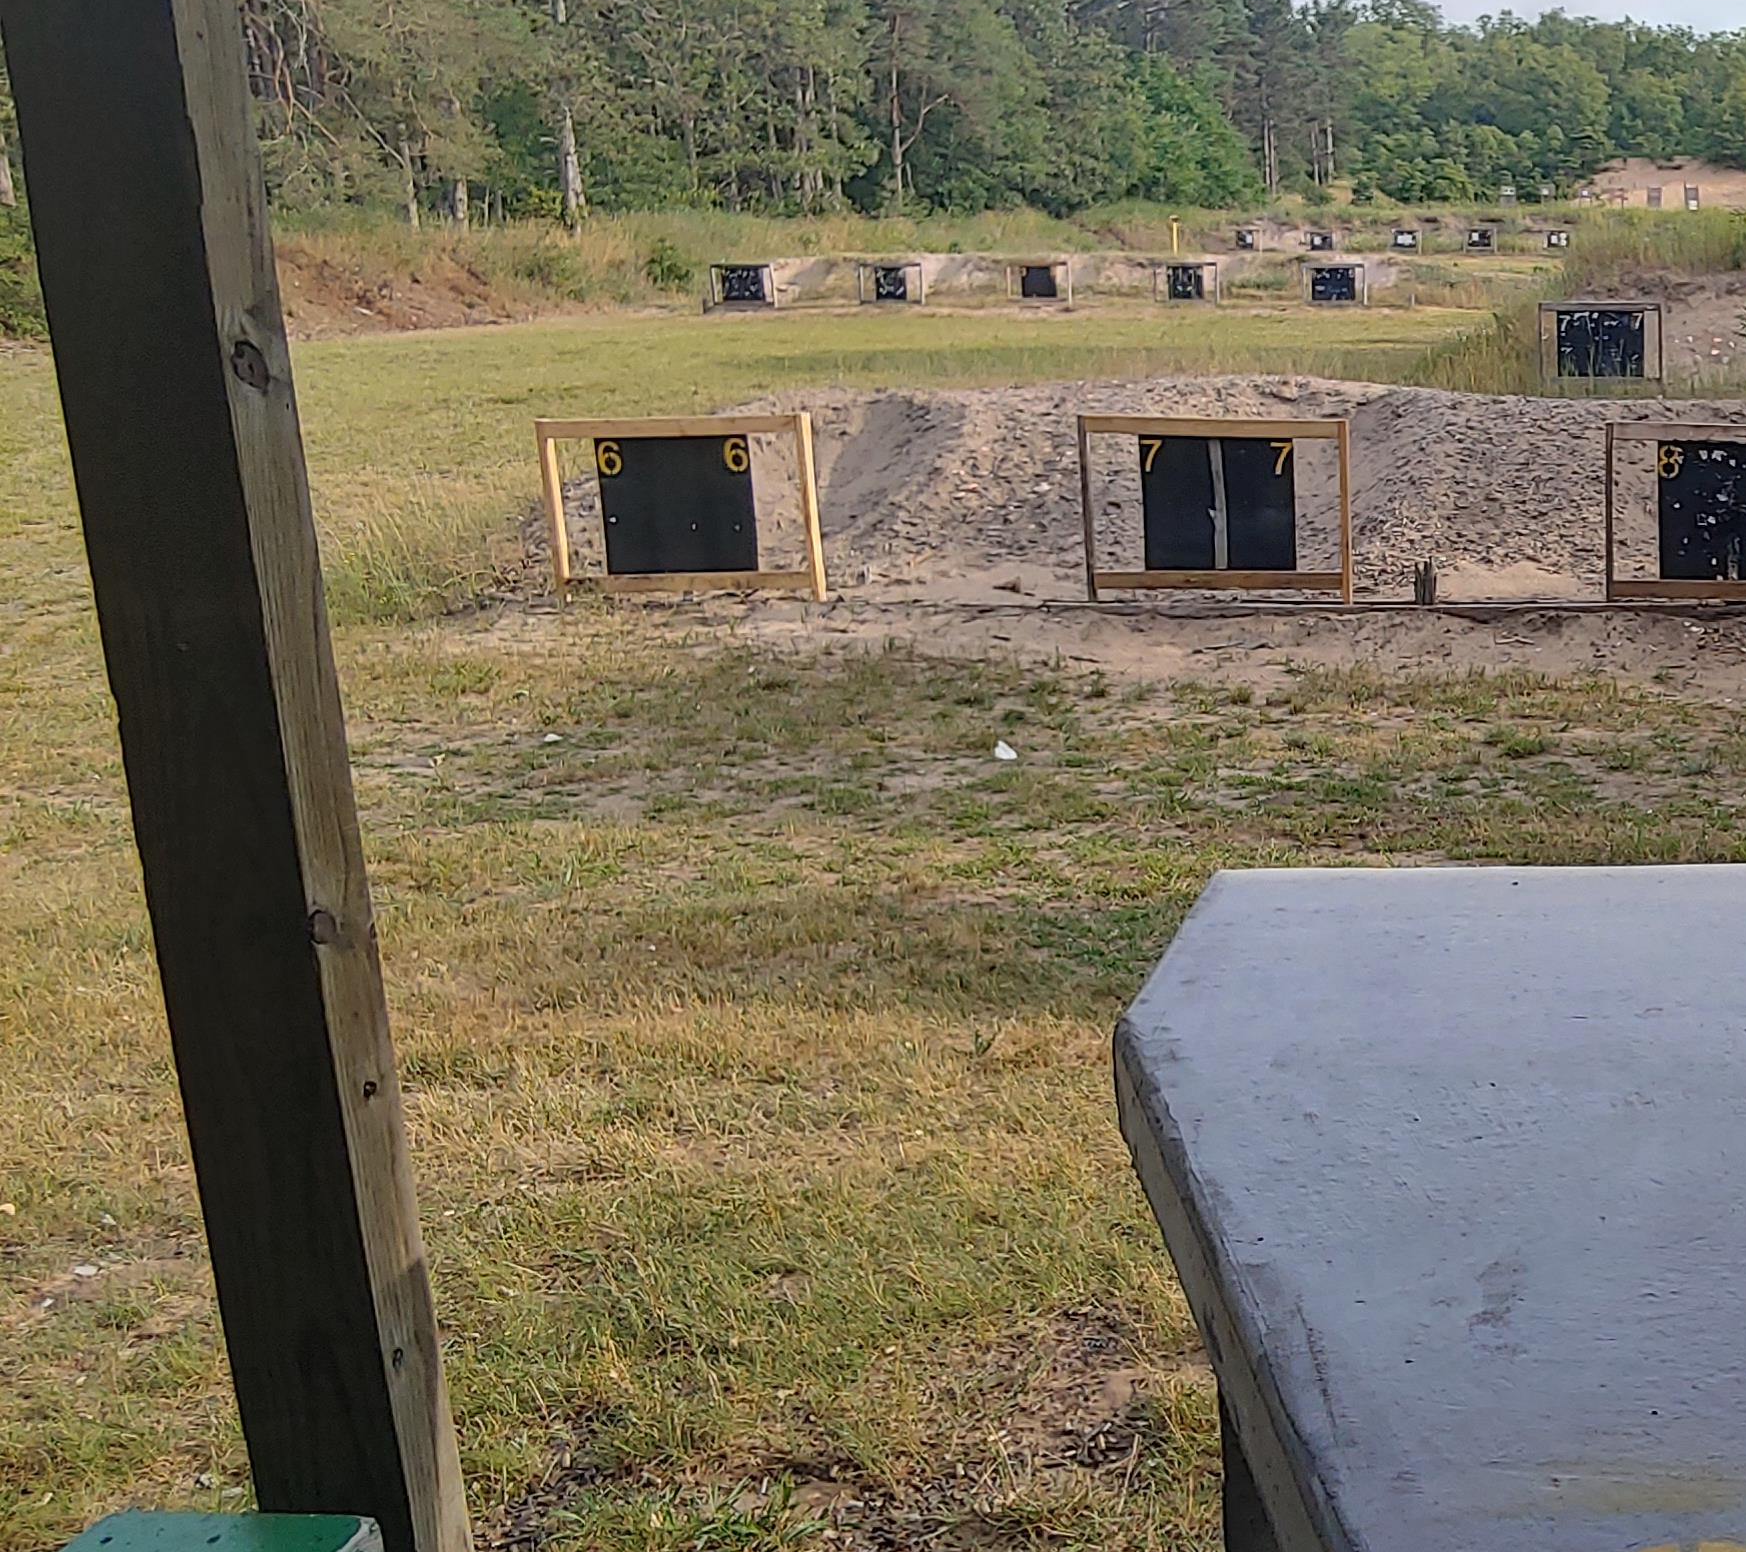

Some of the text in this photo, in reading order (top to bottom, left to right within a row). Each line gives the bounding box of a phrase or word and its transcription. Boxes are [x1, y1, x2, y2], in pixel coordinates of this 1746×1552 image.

[597, 437, 750, 477] 6 6
[1140, 439, 1293, 476] 7 7
[1659, 445, 1684, 479] 8
